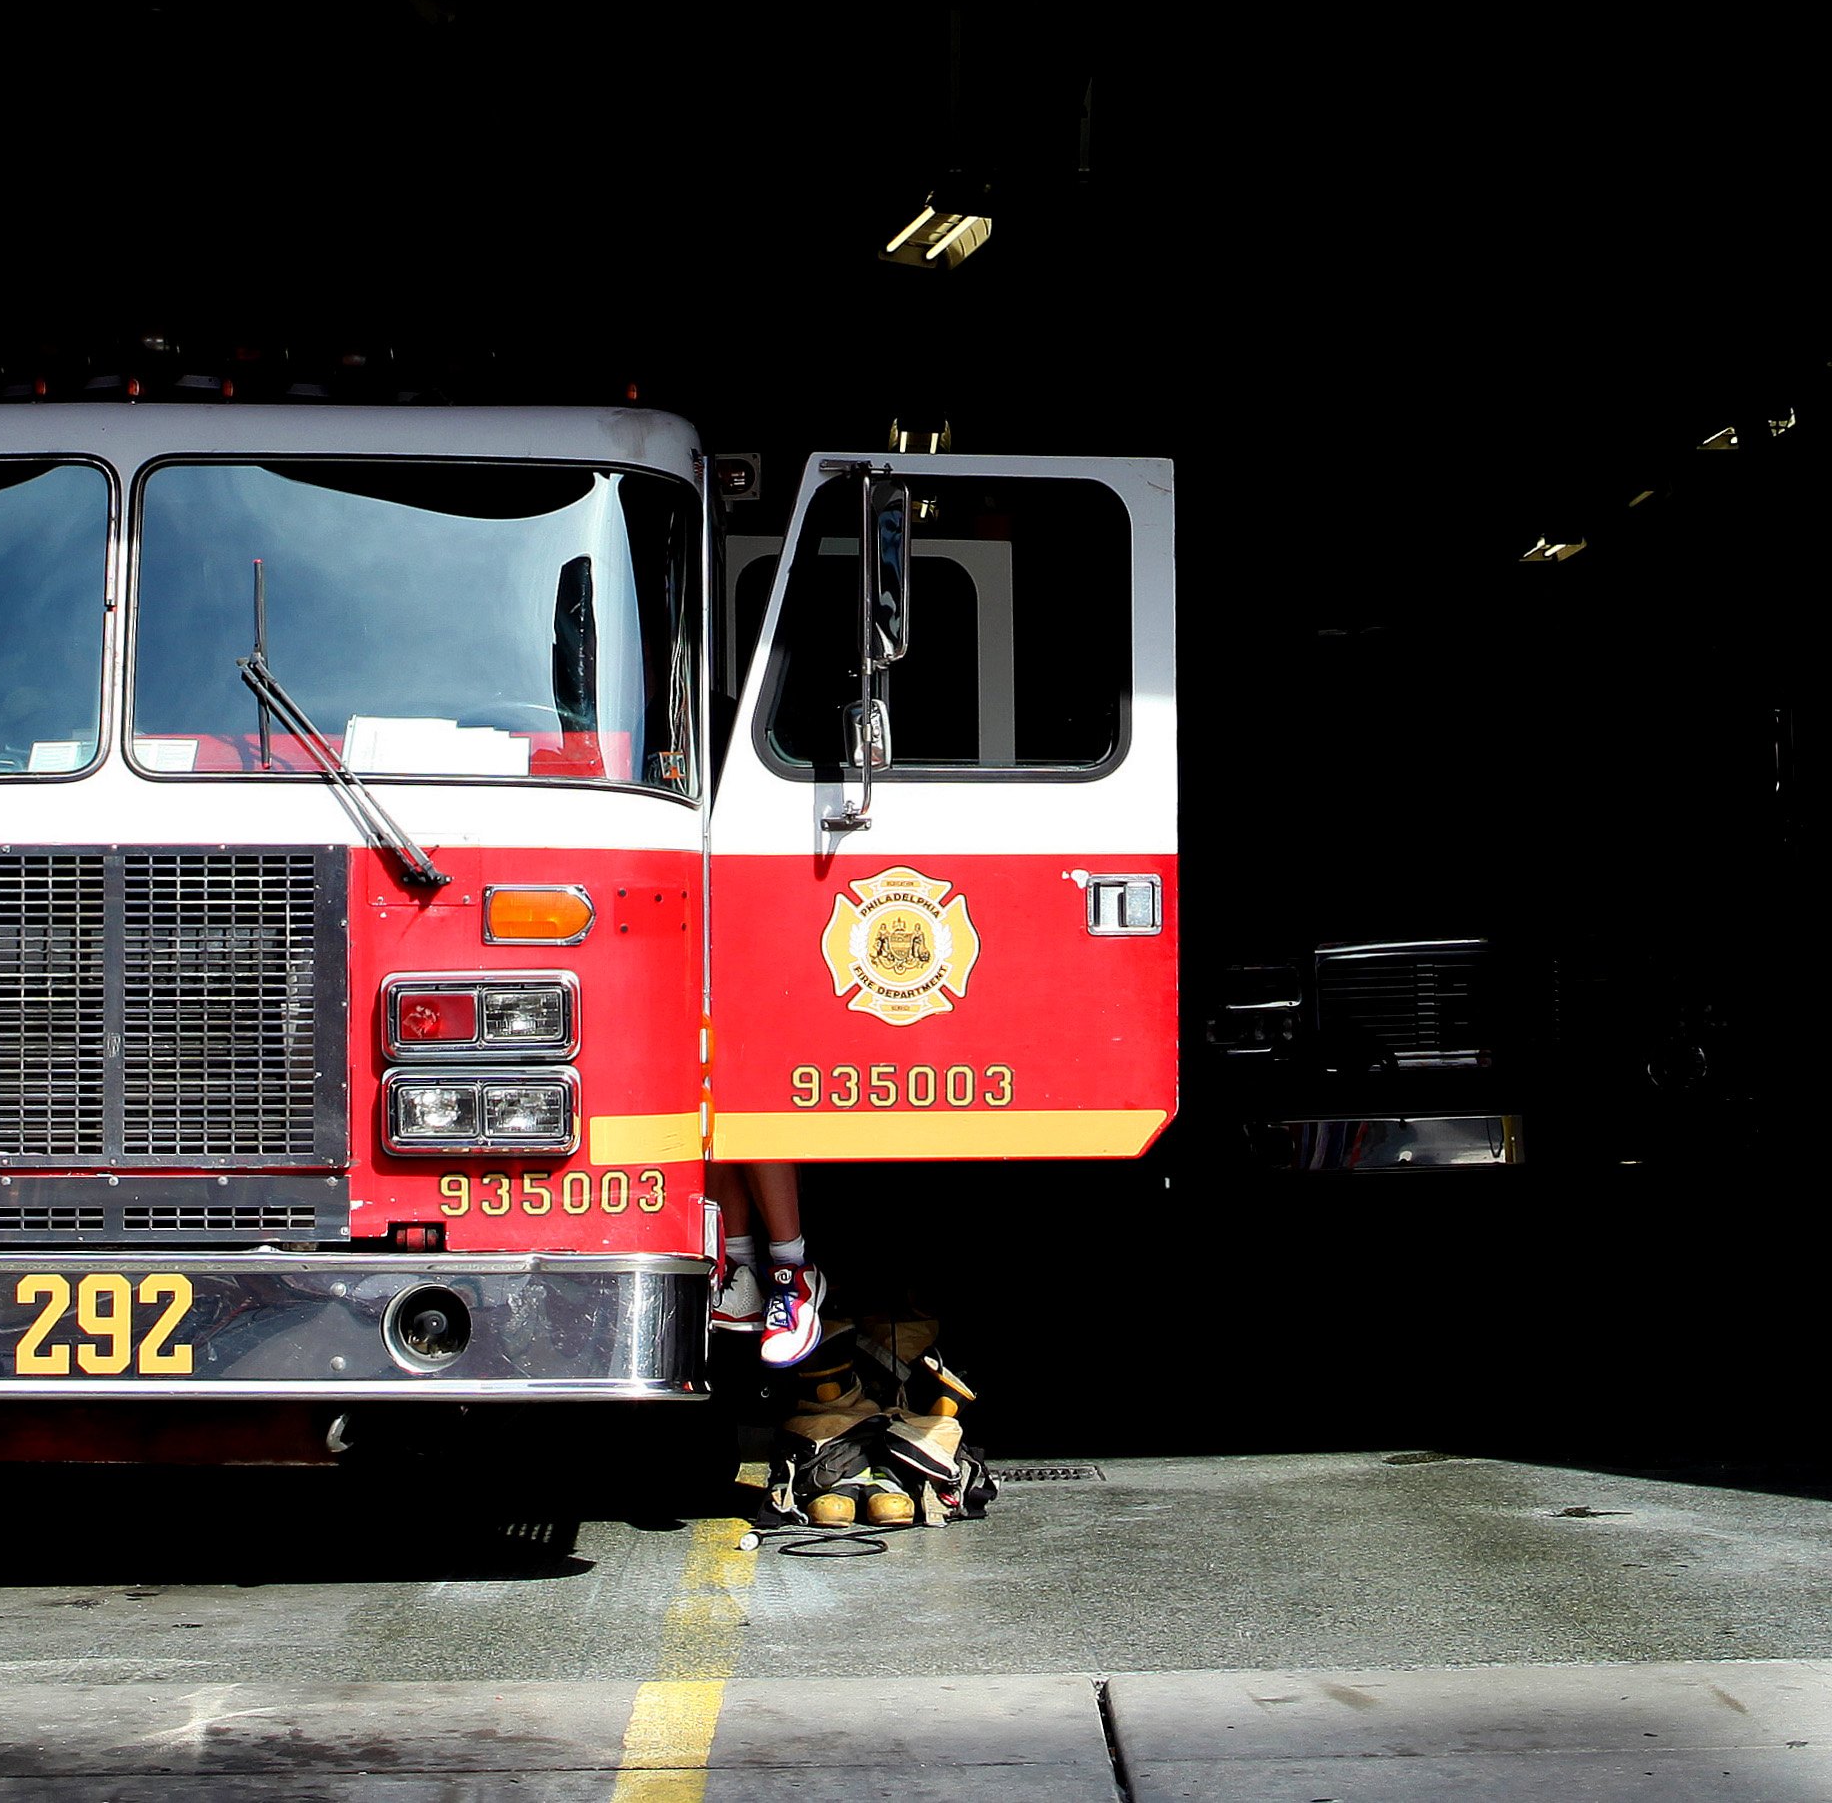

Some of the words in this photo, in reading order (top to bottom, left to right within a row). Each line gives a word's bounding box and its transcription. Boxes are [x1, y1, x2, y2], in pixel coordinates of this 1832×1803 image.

[860, 892, 941, 919] PHILADELPHIA
[853, 965, 874, 990] FIRE
[877, 964, 949, 999] DEPARTMENT
[791, 1064, 1014, 1108] 935003
[440, 1169, 666, 1216] 935003
[16, 1273, 194, 1375] 292
